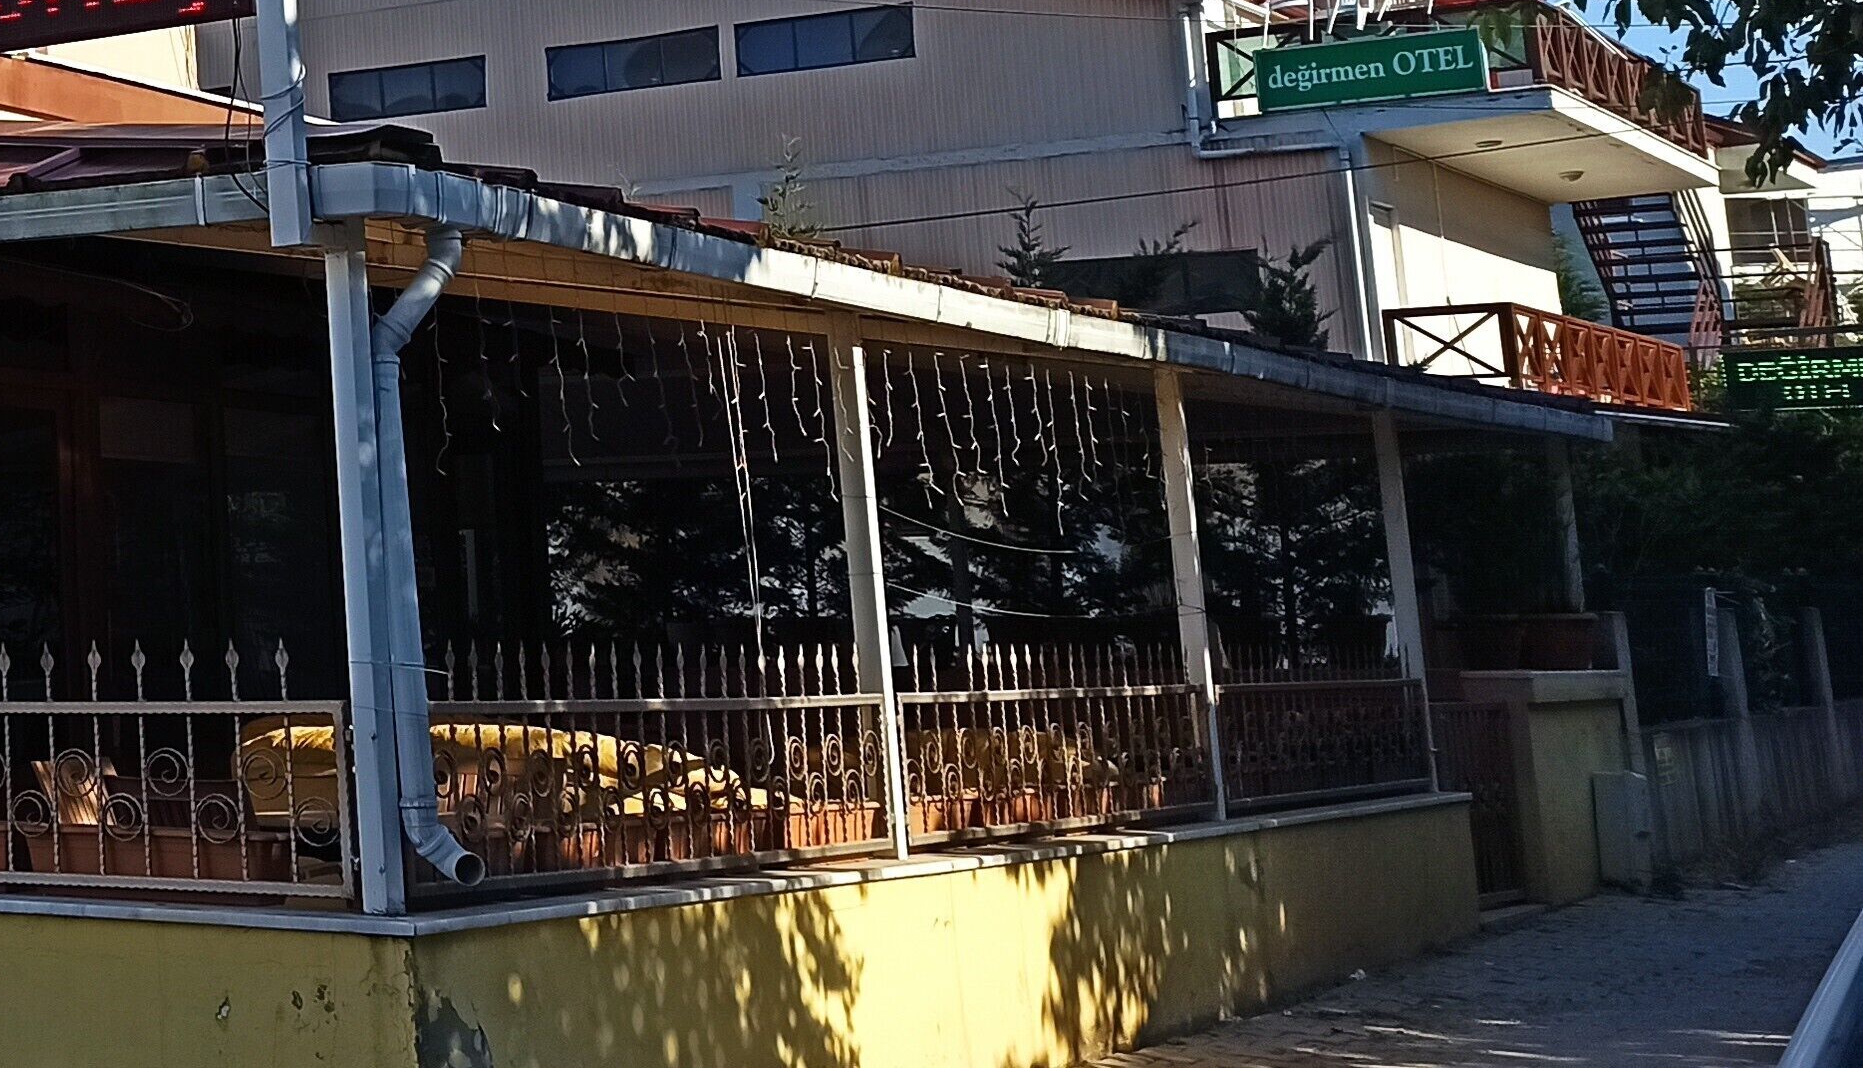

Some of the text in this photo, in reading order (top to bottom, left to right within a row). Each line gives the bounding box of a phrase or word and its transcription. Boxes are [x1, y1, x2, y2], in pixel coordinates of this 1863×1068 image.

[1268, 45, 1473, 92] değirmen OTEL
[1737, 355, 1863, 382] DEĞİRM
